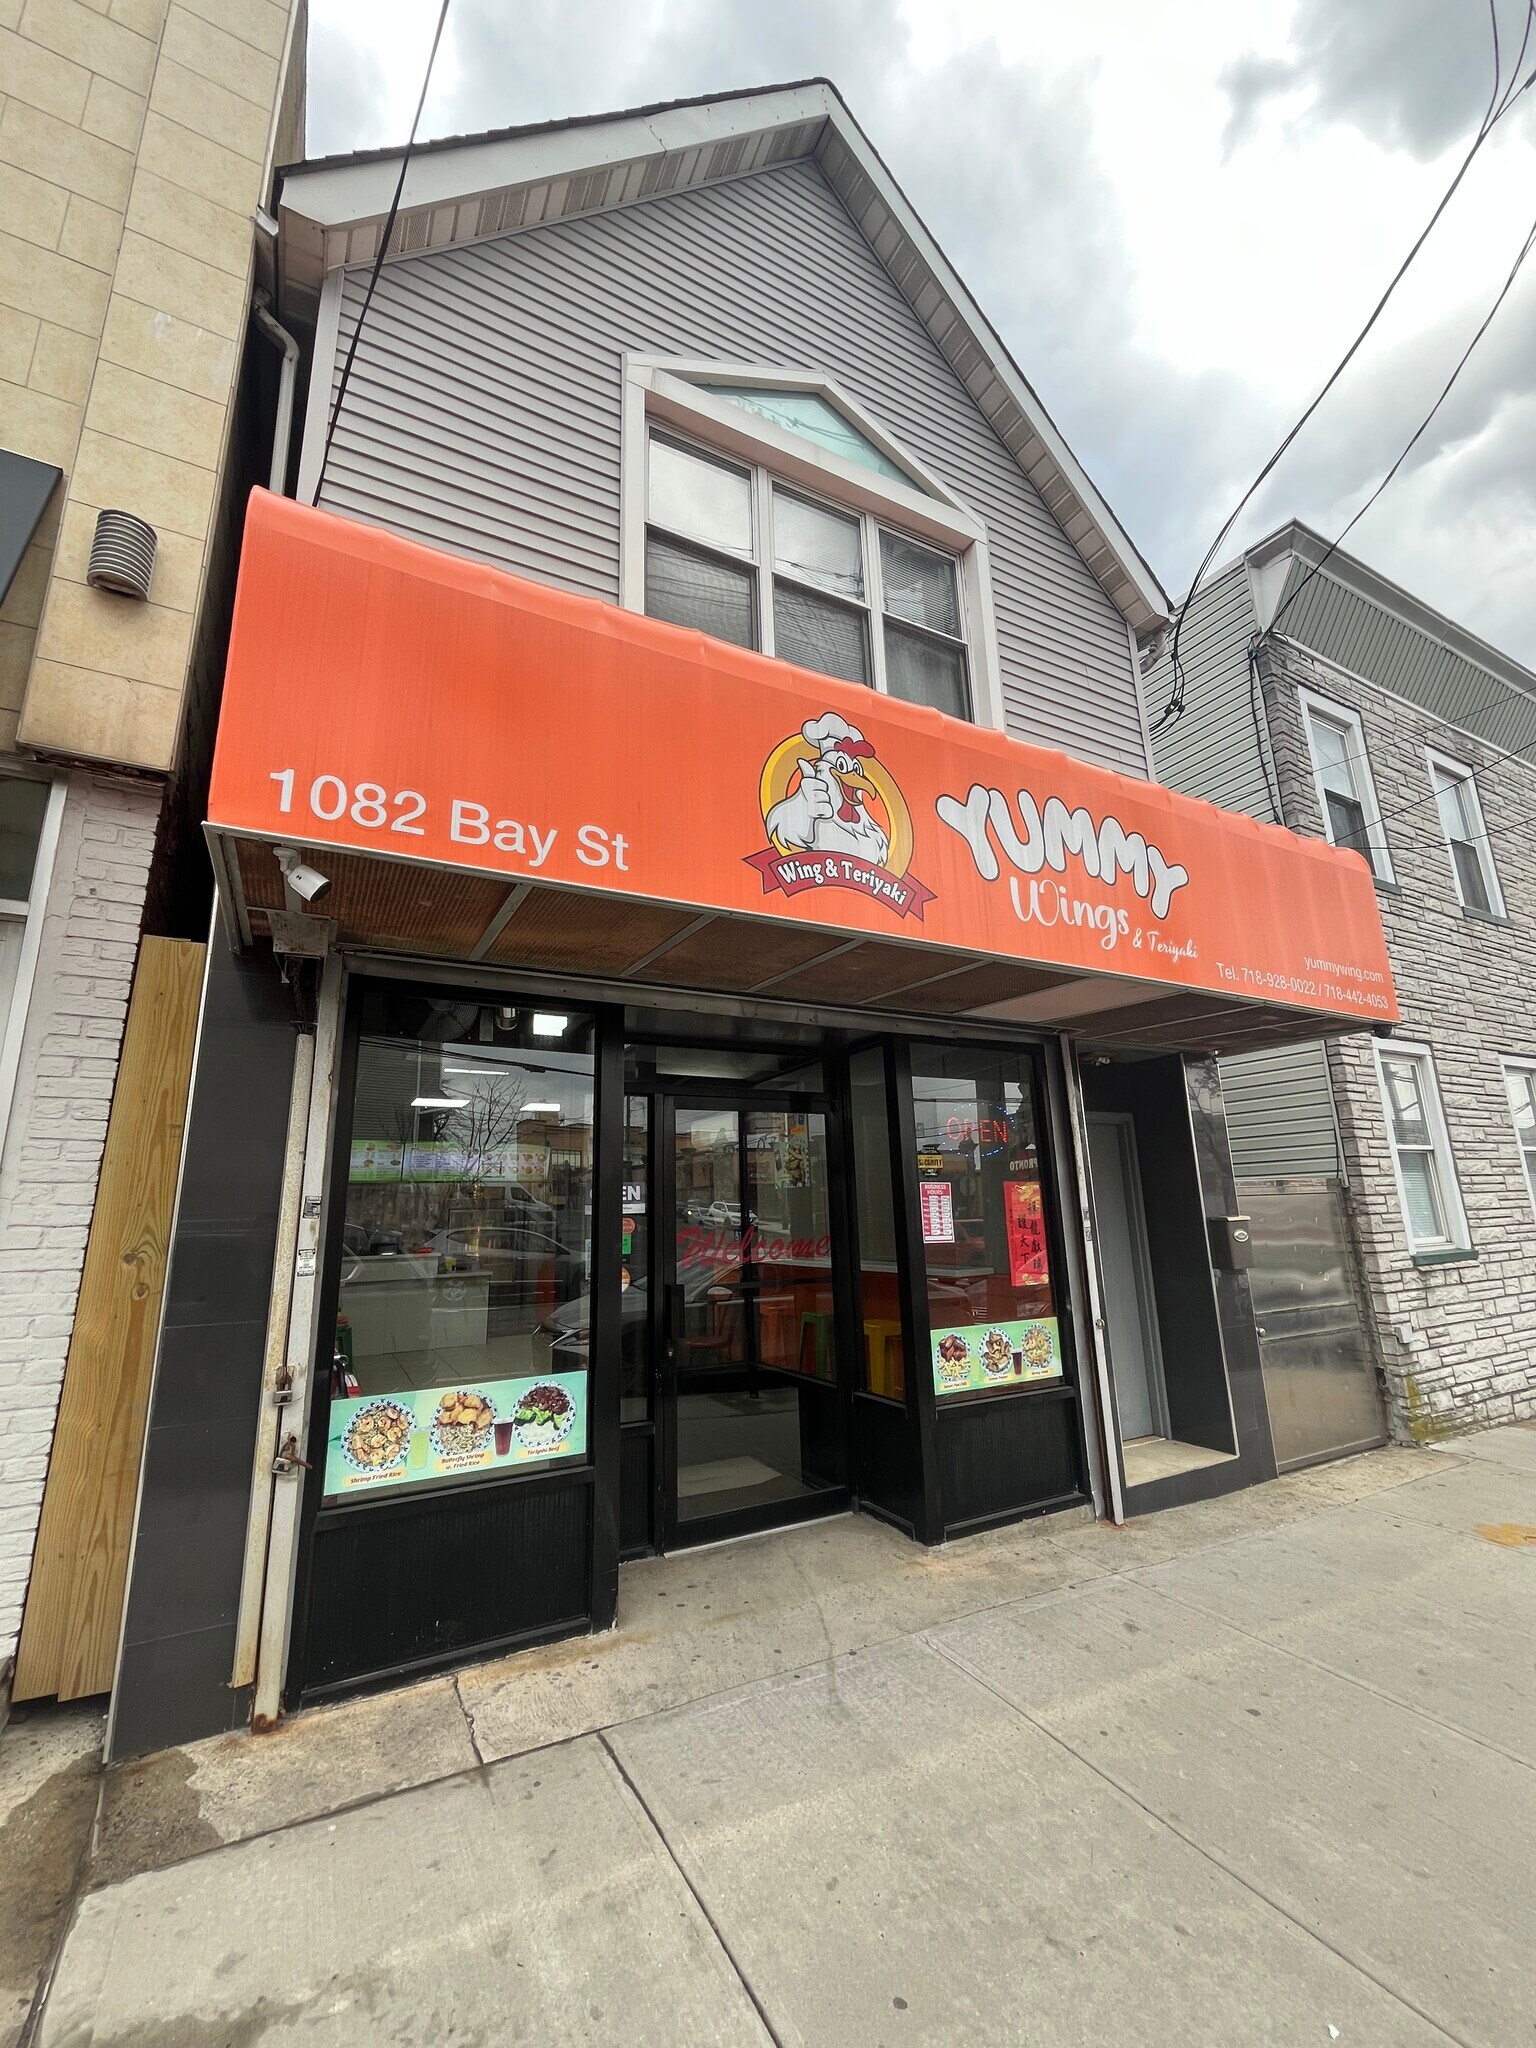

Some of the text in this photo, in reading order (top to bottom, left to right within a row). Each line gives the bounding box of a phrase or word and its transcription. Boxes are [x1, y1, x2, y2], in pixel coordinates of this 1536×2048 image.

[269, 768, 629, 871] 1082 Bay St
[935, 783, 1189, 920] YUMMY
[777, 858, 908, 906] Wing & Teriyaki
[1009, 876, 1199, 963] Wings & Teriyaki
[1216, 962, 1240, 981] Tel.
[1241, 967, 1316, 996] 718-928-0022
[1324, 984, 1389, 1009] 718-442-4053
[1304, 956, 1384, 983] yummywing.com
[946, 1116, 1008, 1143] OPEN
[676, 1225, 831, 1269] Welcome
[350, 1470, 402, 1485] Shrimp Fried Rice
[465, 1452, 485, 1463] Shrimp
